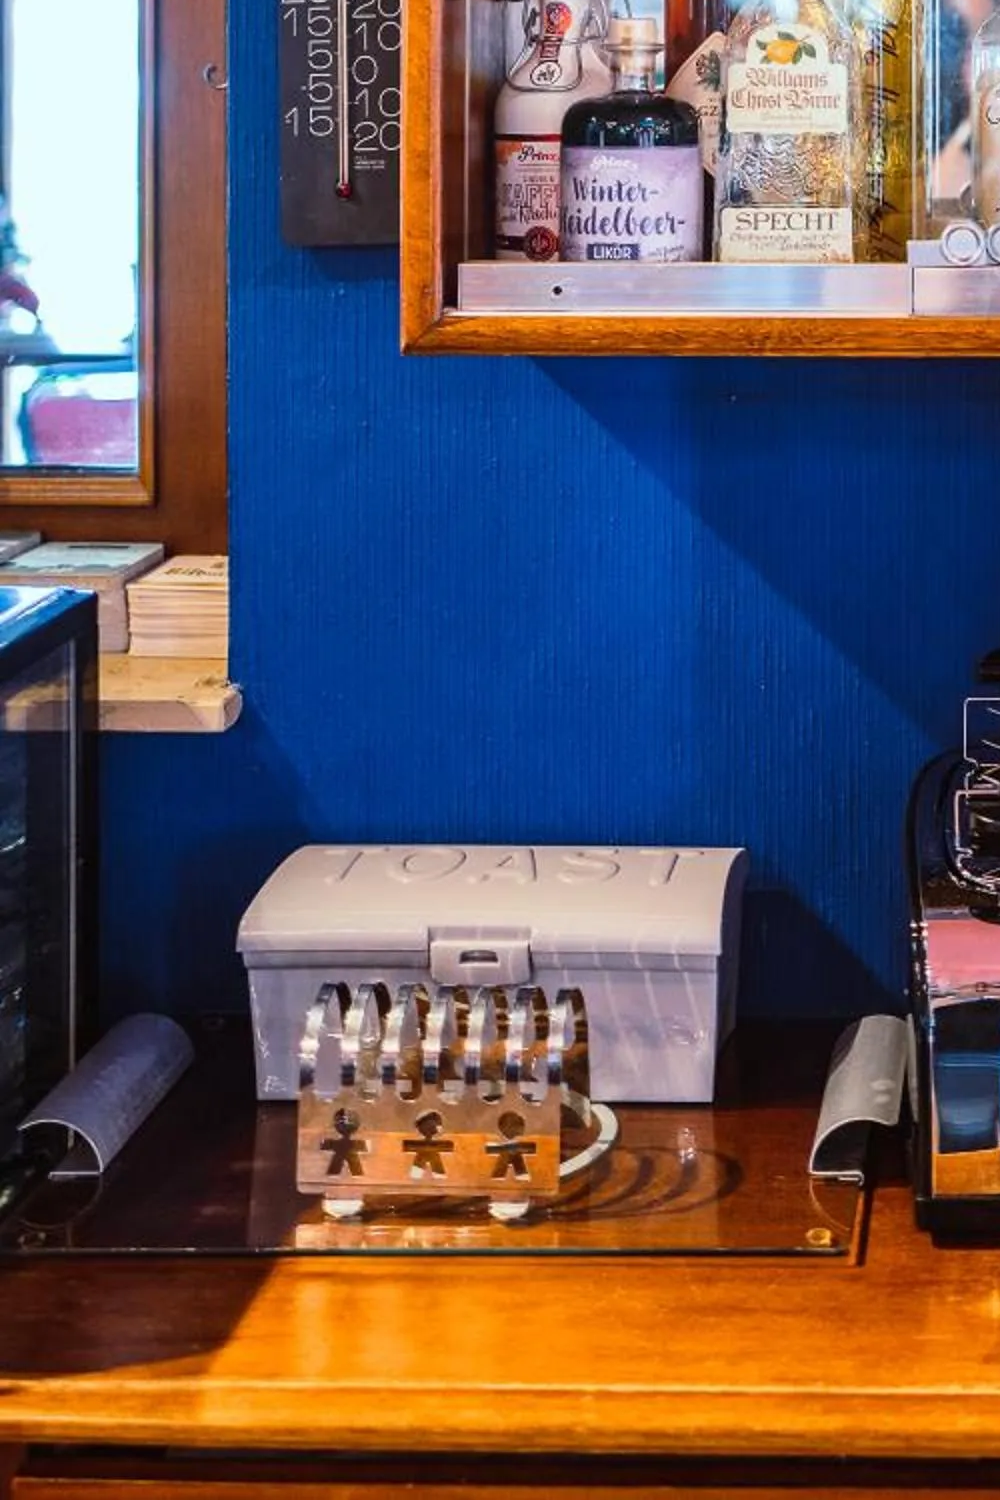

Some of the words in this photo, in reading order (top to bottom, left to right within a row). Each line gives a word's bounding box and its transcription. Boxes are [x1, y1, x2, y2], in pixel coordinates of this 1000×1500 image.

[283, 7, 333, 37] 15
[355, 22, 401, 51] 10
[308, 40, 333, 70] 5
[352, 55, 378, 85] 0
[572, 177, 660, 203] Winter-
[735, 211, 839, 232] SPECHT
[322, 847, 706, 885] TOAST
